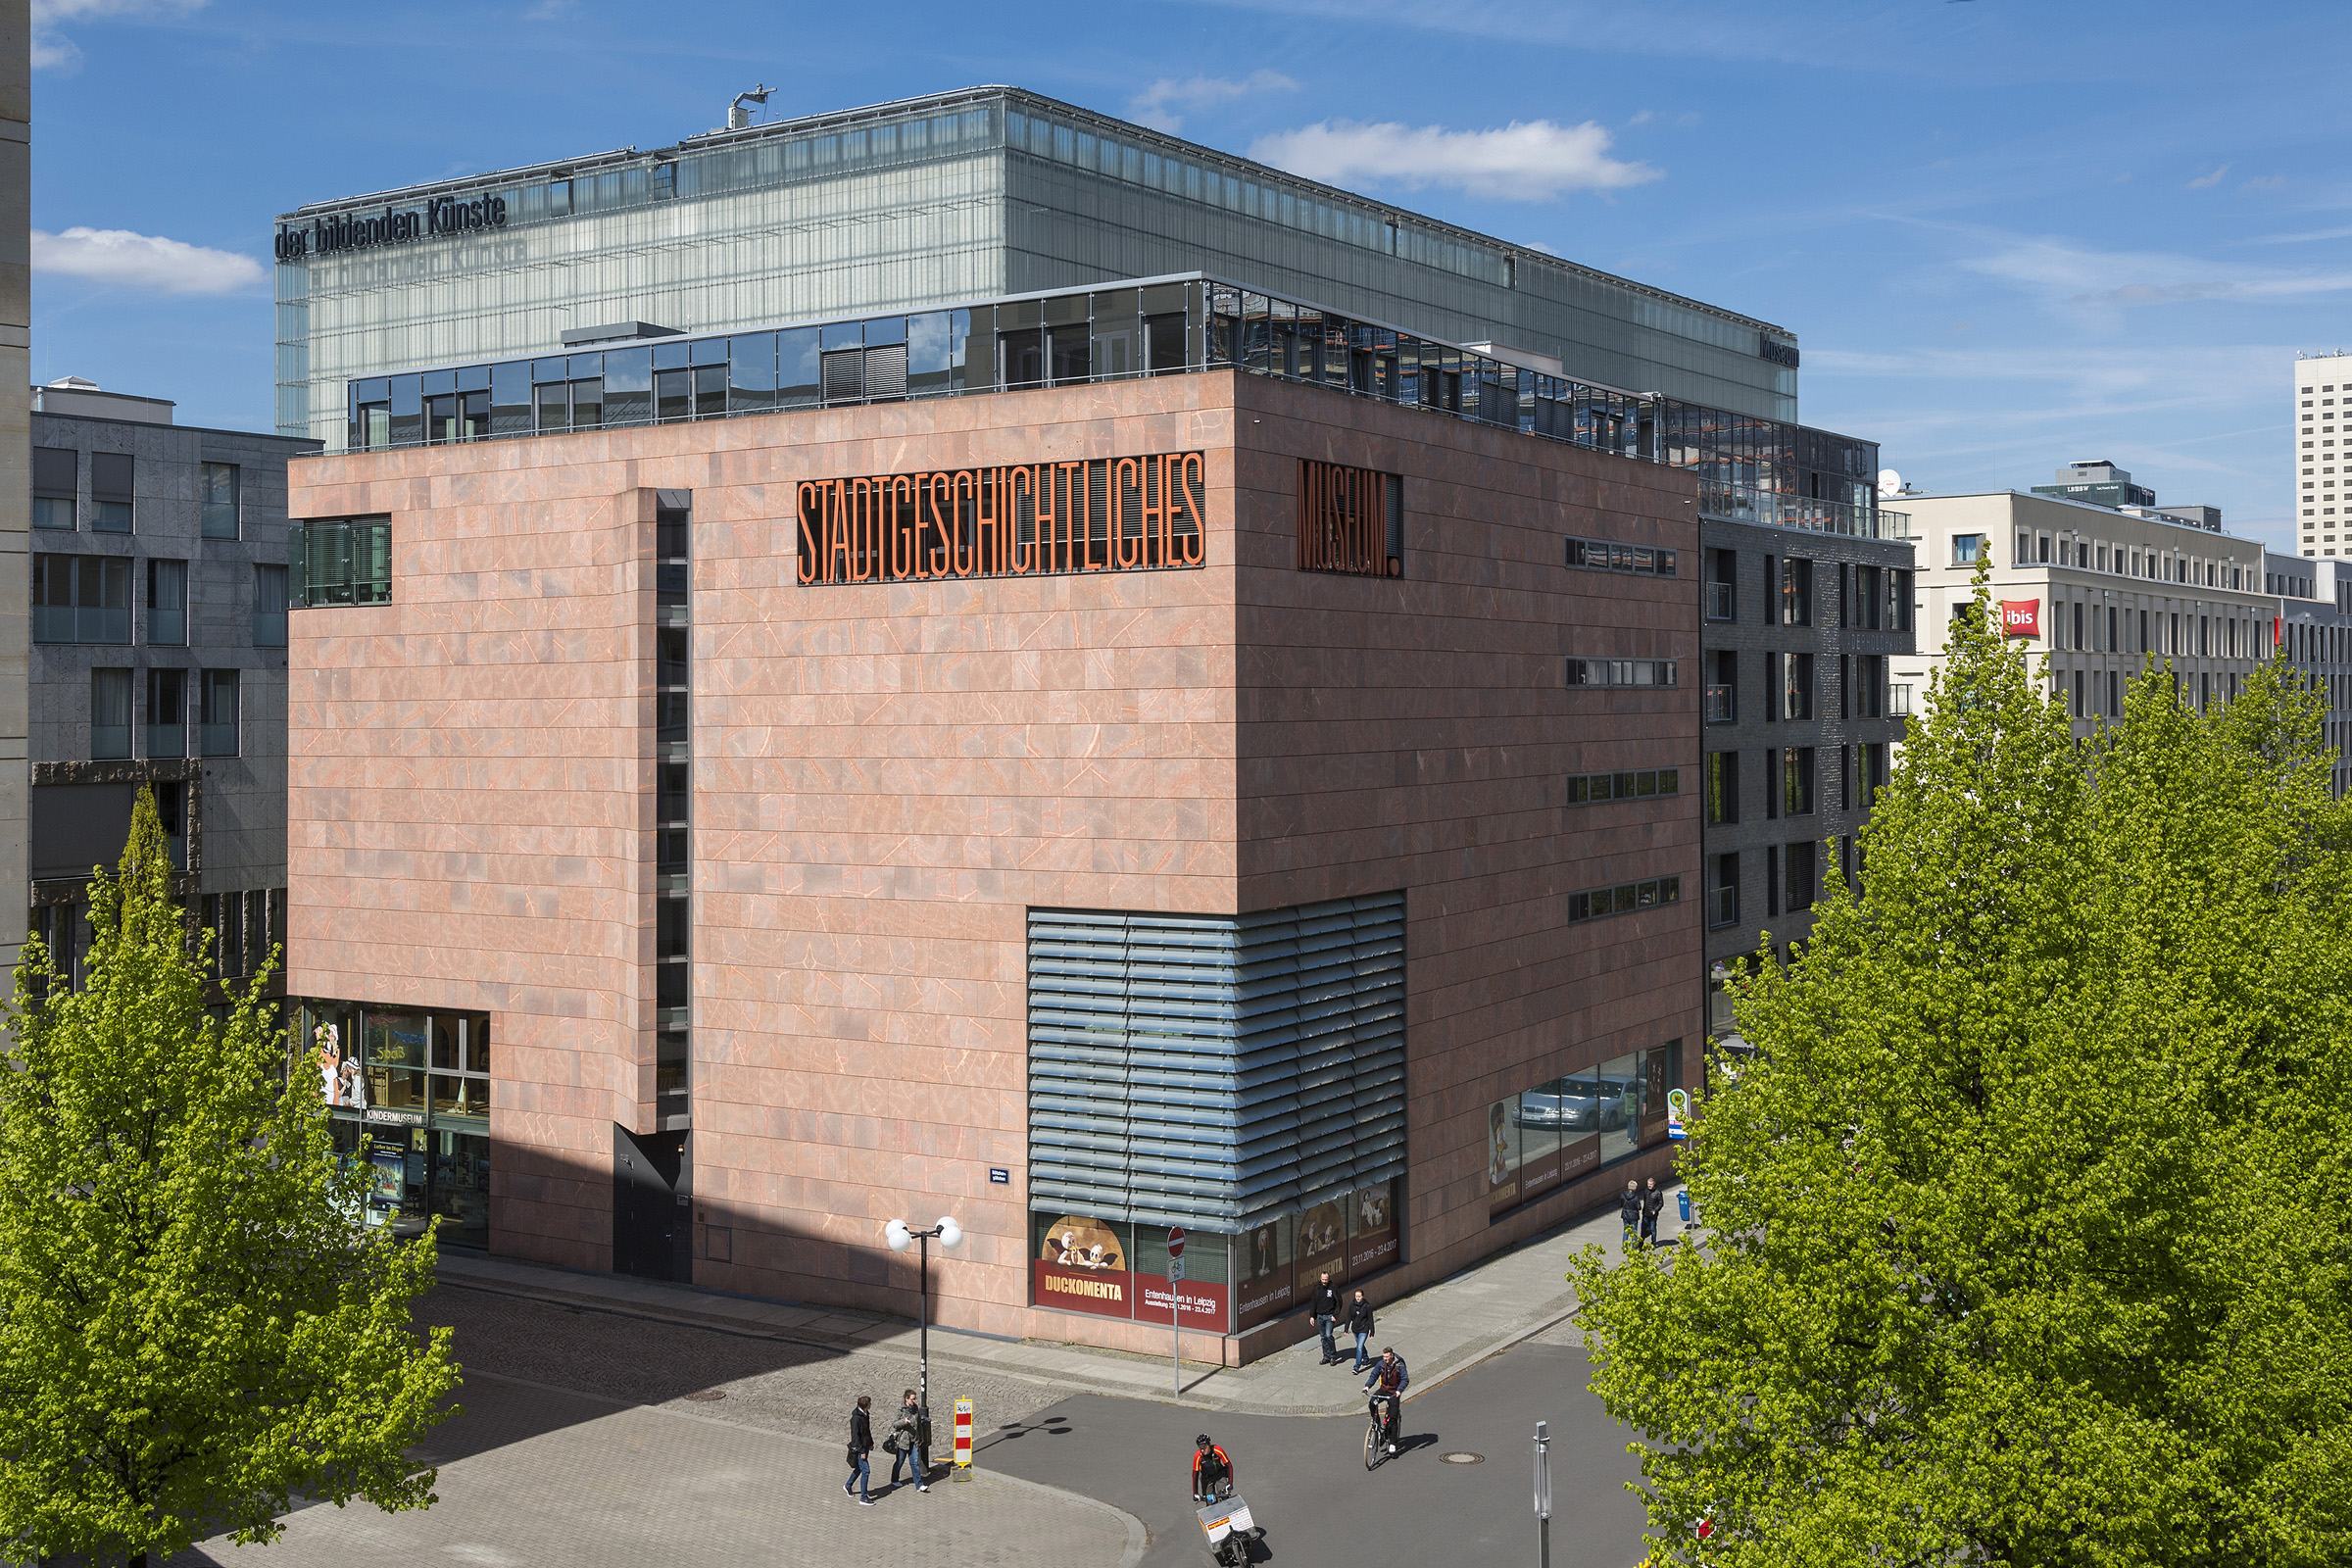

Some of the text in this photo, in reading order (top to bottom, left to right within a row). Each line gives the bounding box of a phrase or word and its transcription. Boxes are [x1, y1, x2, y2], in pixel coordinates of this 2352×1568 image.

[274, 192, 506, 259] der bildenden Künste
[1760, 333, 1800, 368] Museum
[798, 452, 1204, 586] STADTGESCHICHTLICHES
[2006, 610, 2034, 625] ibis
[367, 1109, 422, 1125] KINDERMUSEUM
[1045, 1275, 1122, 1301] DUCKOMENTA
[1145, 1289, 1216, 1308] Entenhauen in Leipzig
[1239, 1295, 1269, 1314] Entenhausen
[1275, 1285, 1291, 1299] Leipzig
